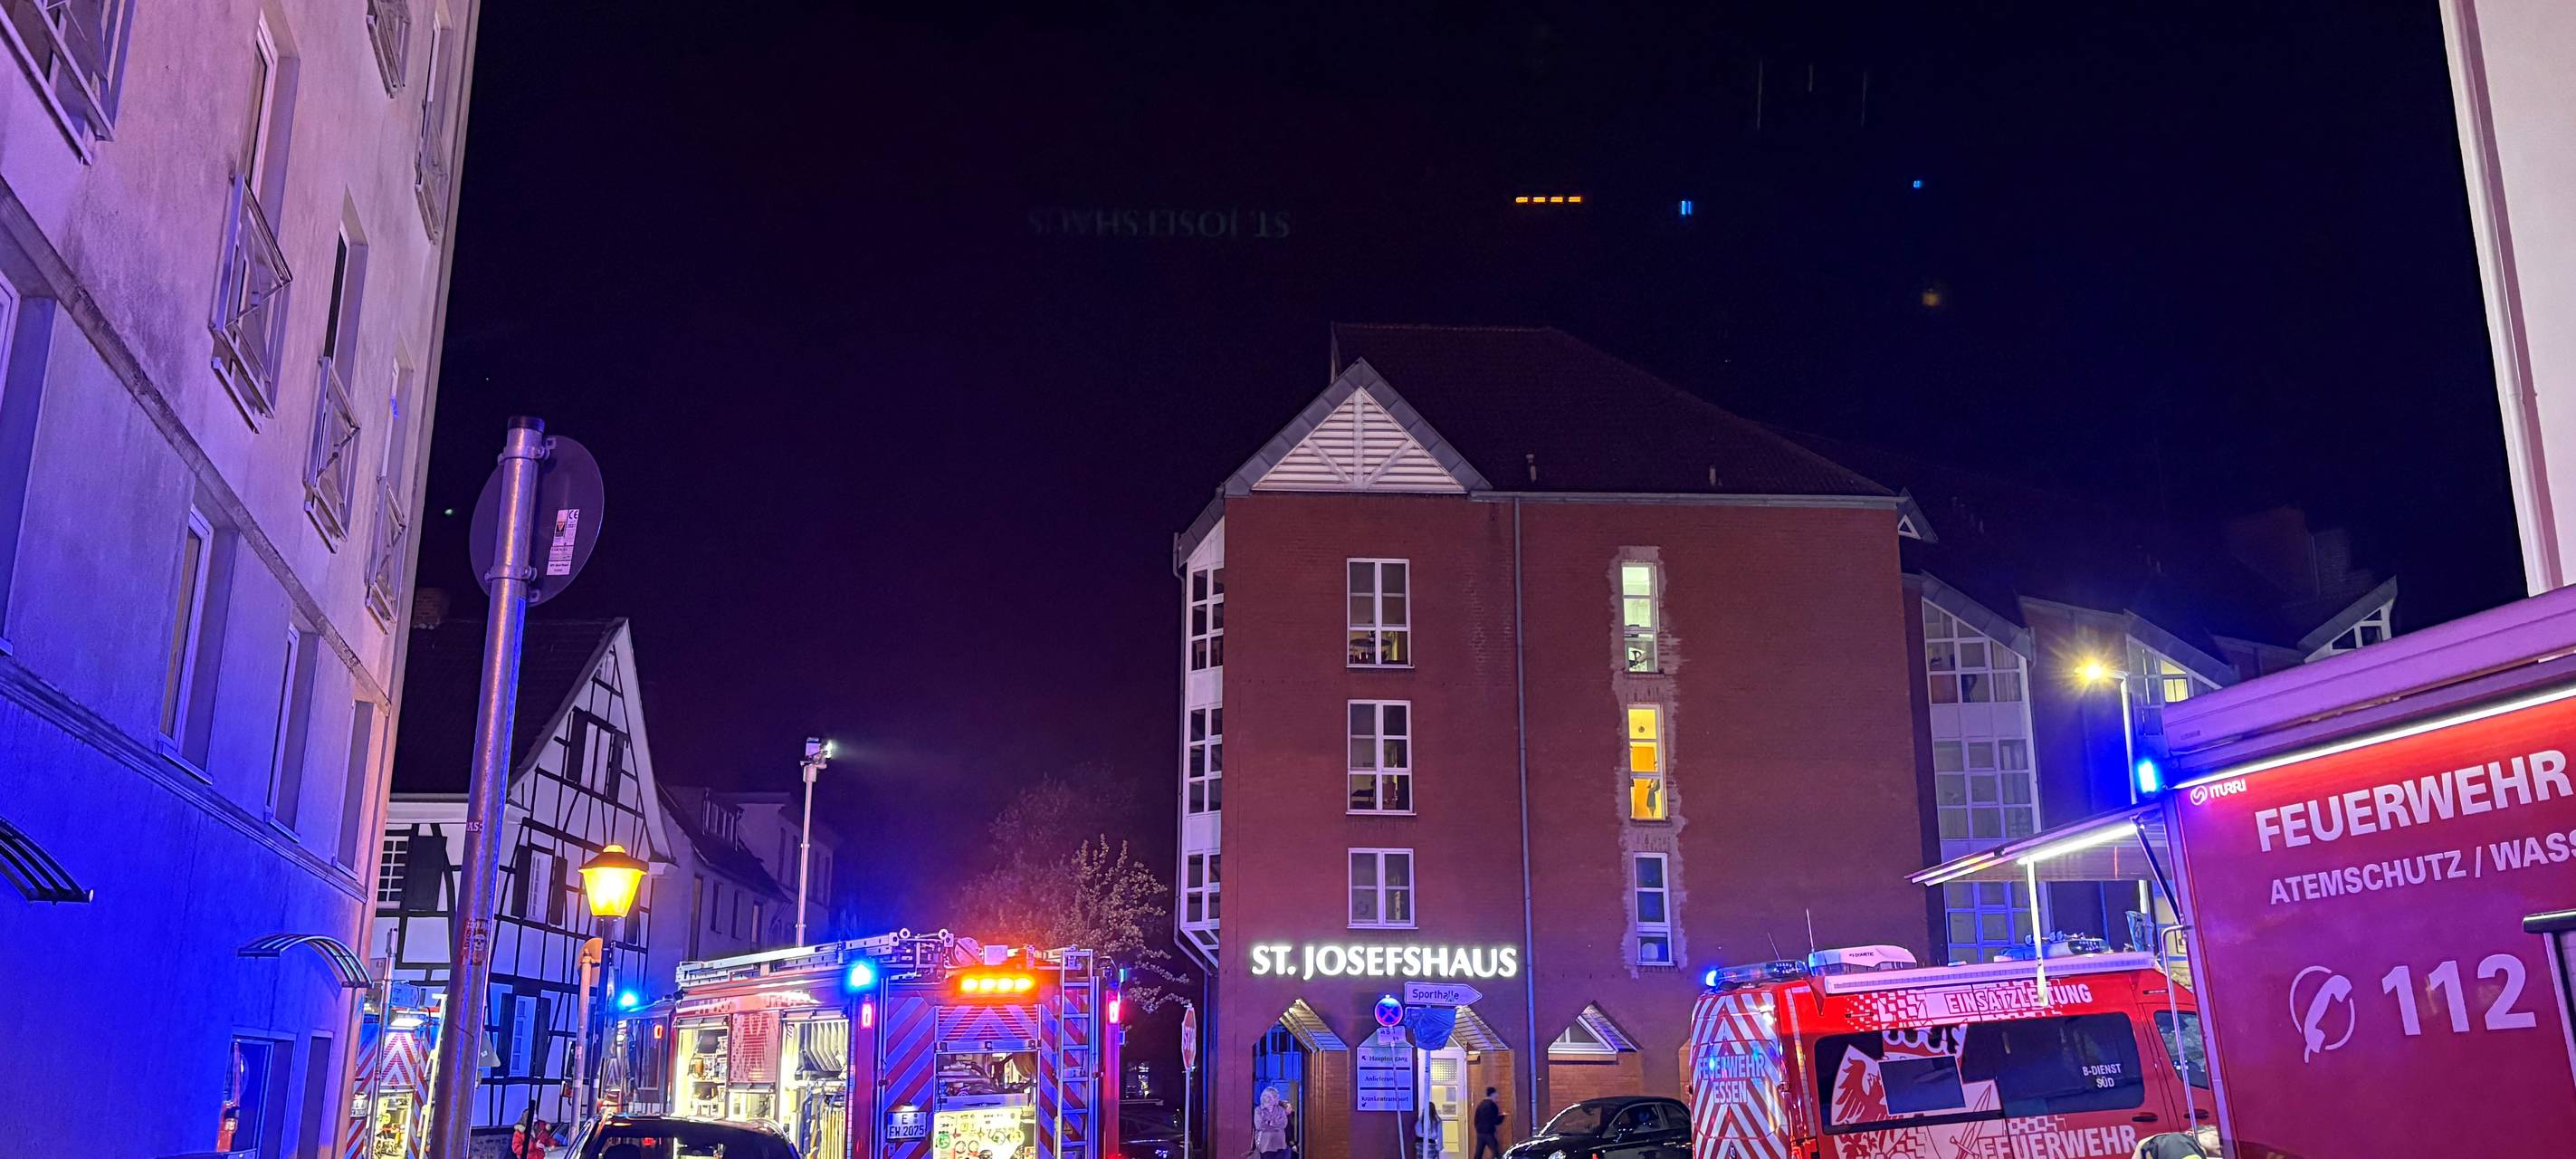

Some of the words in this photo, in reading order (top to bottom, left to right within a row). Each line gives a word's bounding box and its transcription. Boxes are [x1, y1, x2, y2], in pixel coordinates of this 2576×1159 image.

[2255, 750, 2575, 853] FEUERWEHR
[2270, 849, 2466, 905] ATEMSCHUTZ
[1251, 944, 1296, 975] ST.
[1303, 945, 1518, 980] JOSEFSHAUS
[1412, 989, 1460, 1000] Sporthalle
[1944, 983, 2093, 1014] EINSATZLETUNG
[2381, 953, 2537, 1037] 112
[1364, 1075, 1395, 1083] Anlieferun
[1698, 1054, 1766, 1080] FEUERWEHR
[2082, 1063, 2122, 1076] B-DIENST
[1713, 1080, 1748, 1104] ESSEN
[2095, 1076, 2115, 1088] SÜD
[902, 1114, 908, 1125] E
[903, 1125, 924, 1136] 2075
